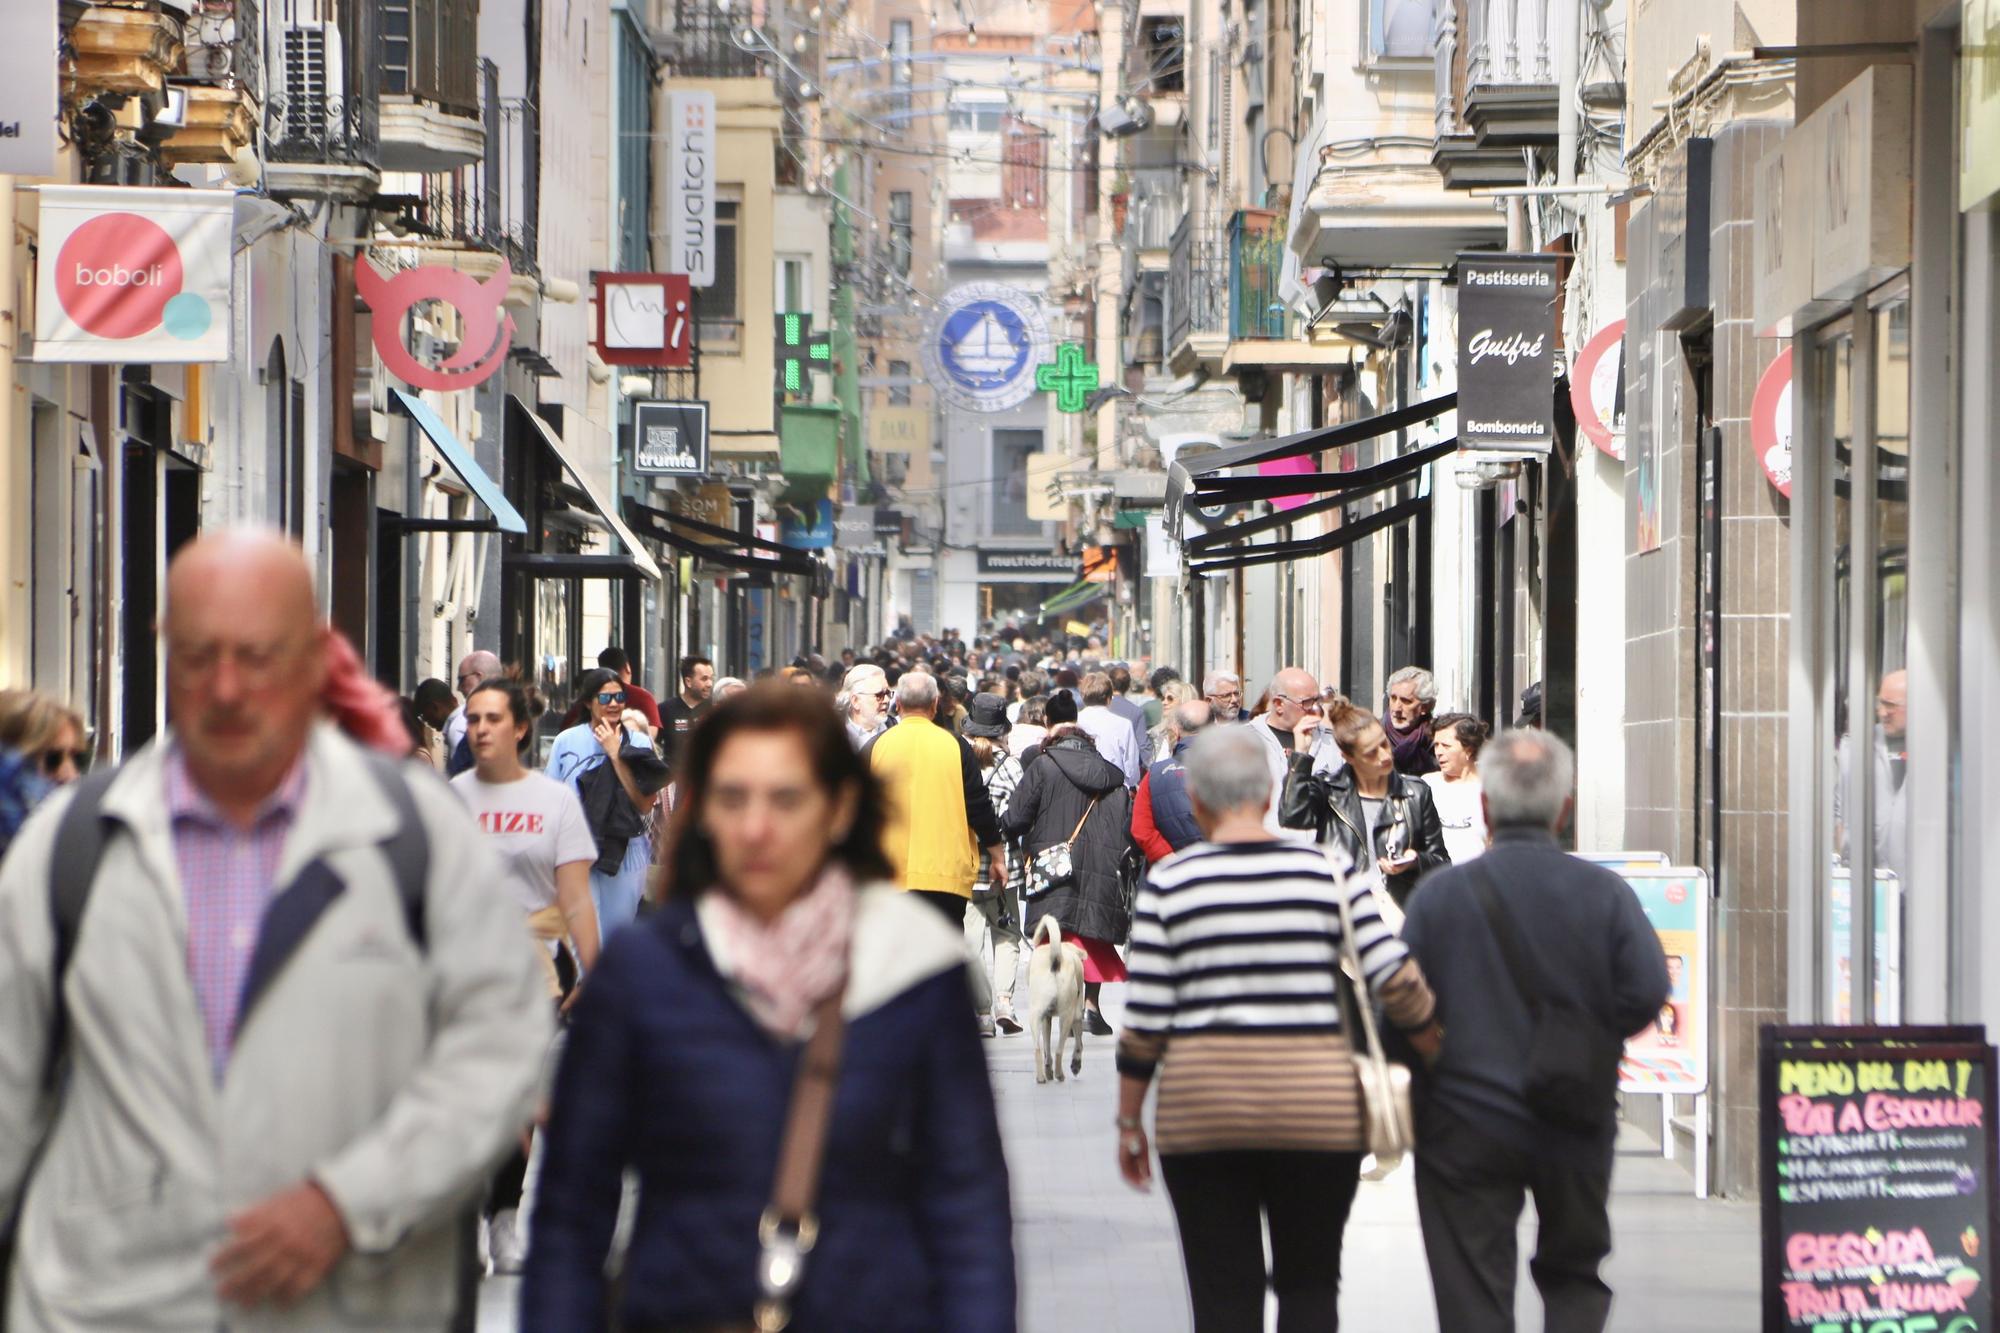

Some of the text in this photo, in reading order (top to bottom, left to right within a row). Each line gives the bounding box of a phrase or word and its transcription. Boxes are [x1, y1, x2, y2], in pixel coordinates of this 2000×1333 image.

[0, 121, 20, 138] el
[681, 130, 705, 273] swatch
[75, 262, 163, 287] boboli
[1466, 269, 1549, 286] Pastisseria
[1468, 328, 1545, 365] Guifré
[1467, 420, 1545, 435] Bomboneria
[1839, 1102, 1864, 1133] A
[1786, 1225, 1936, 1273] BEGUDA
